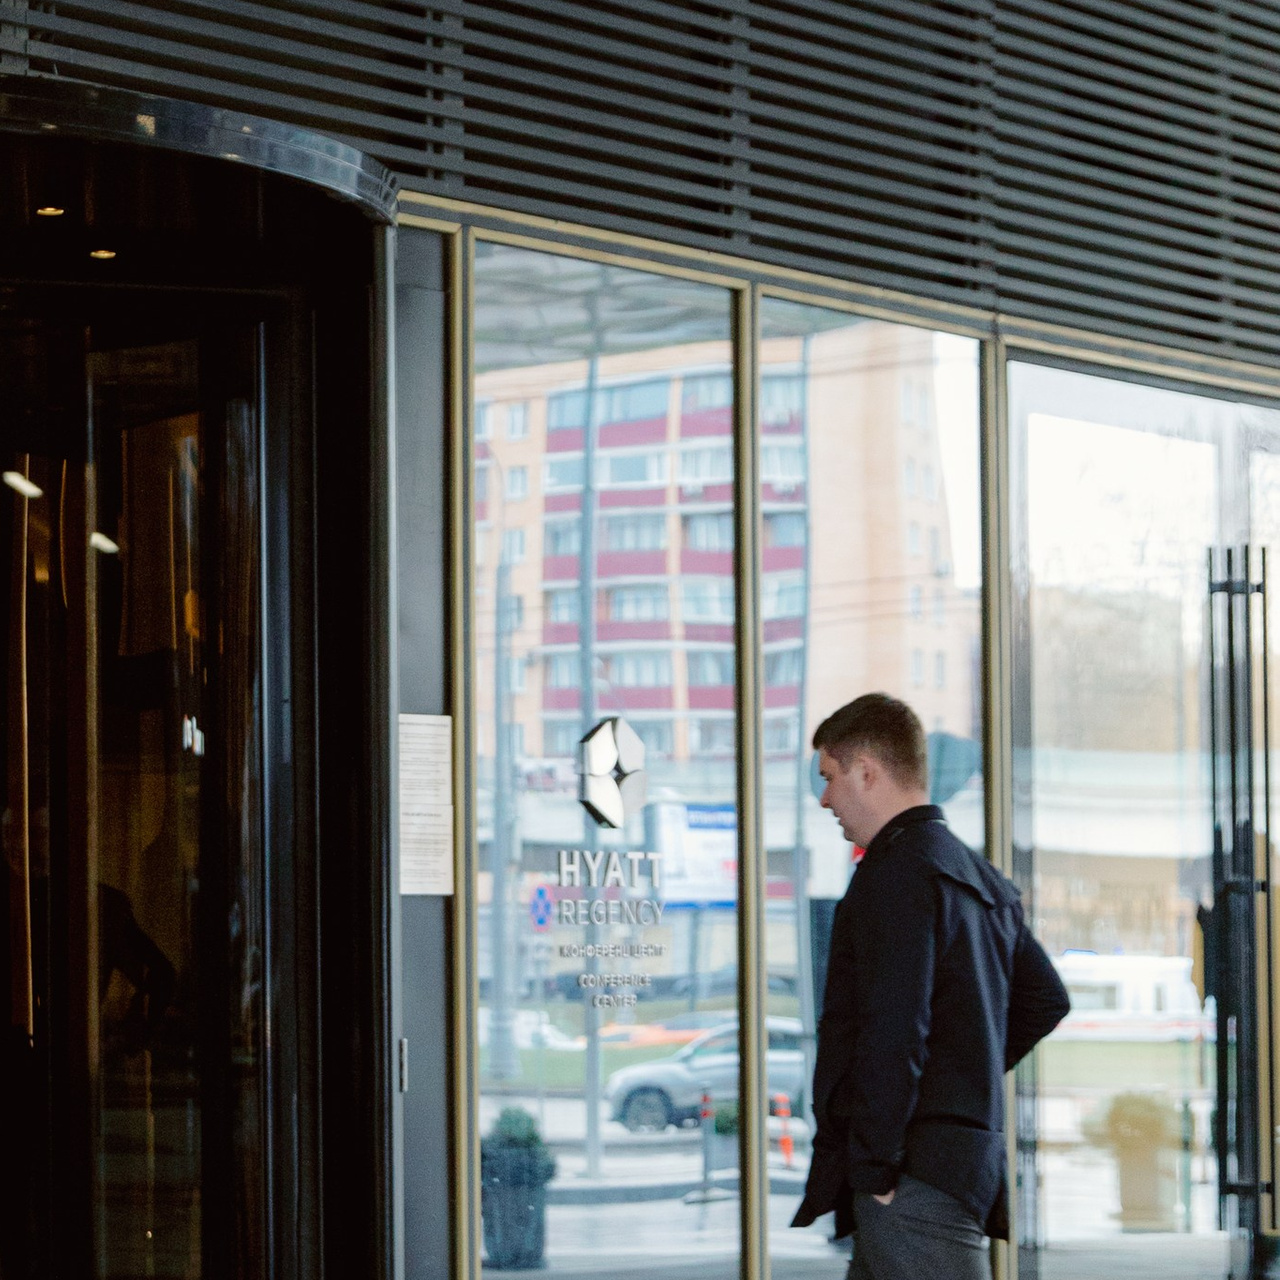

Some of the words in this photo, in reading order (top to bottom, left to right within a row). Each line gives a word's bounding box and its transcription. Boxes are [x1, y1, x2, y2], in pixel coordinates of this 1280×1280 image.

[558, 850, 664, 888] HYATT
[558, 899, 665, 926] REGENCY
[578, 973, 652, 988] CONFERENCE
[592, 994, 638, 1008] CENTER
